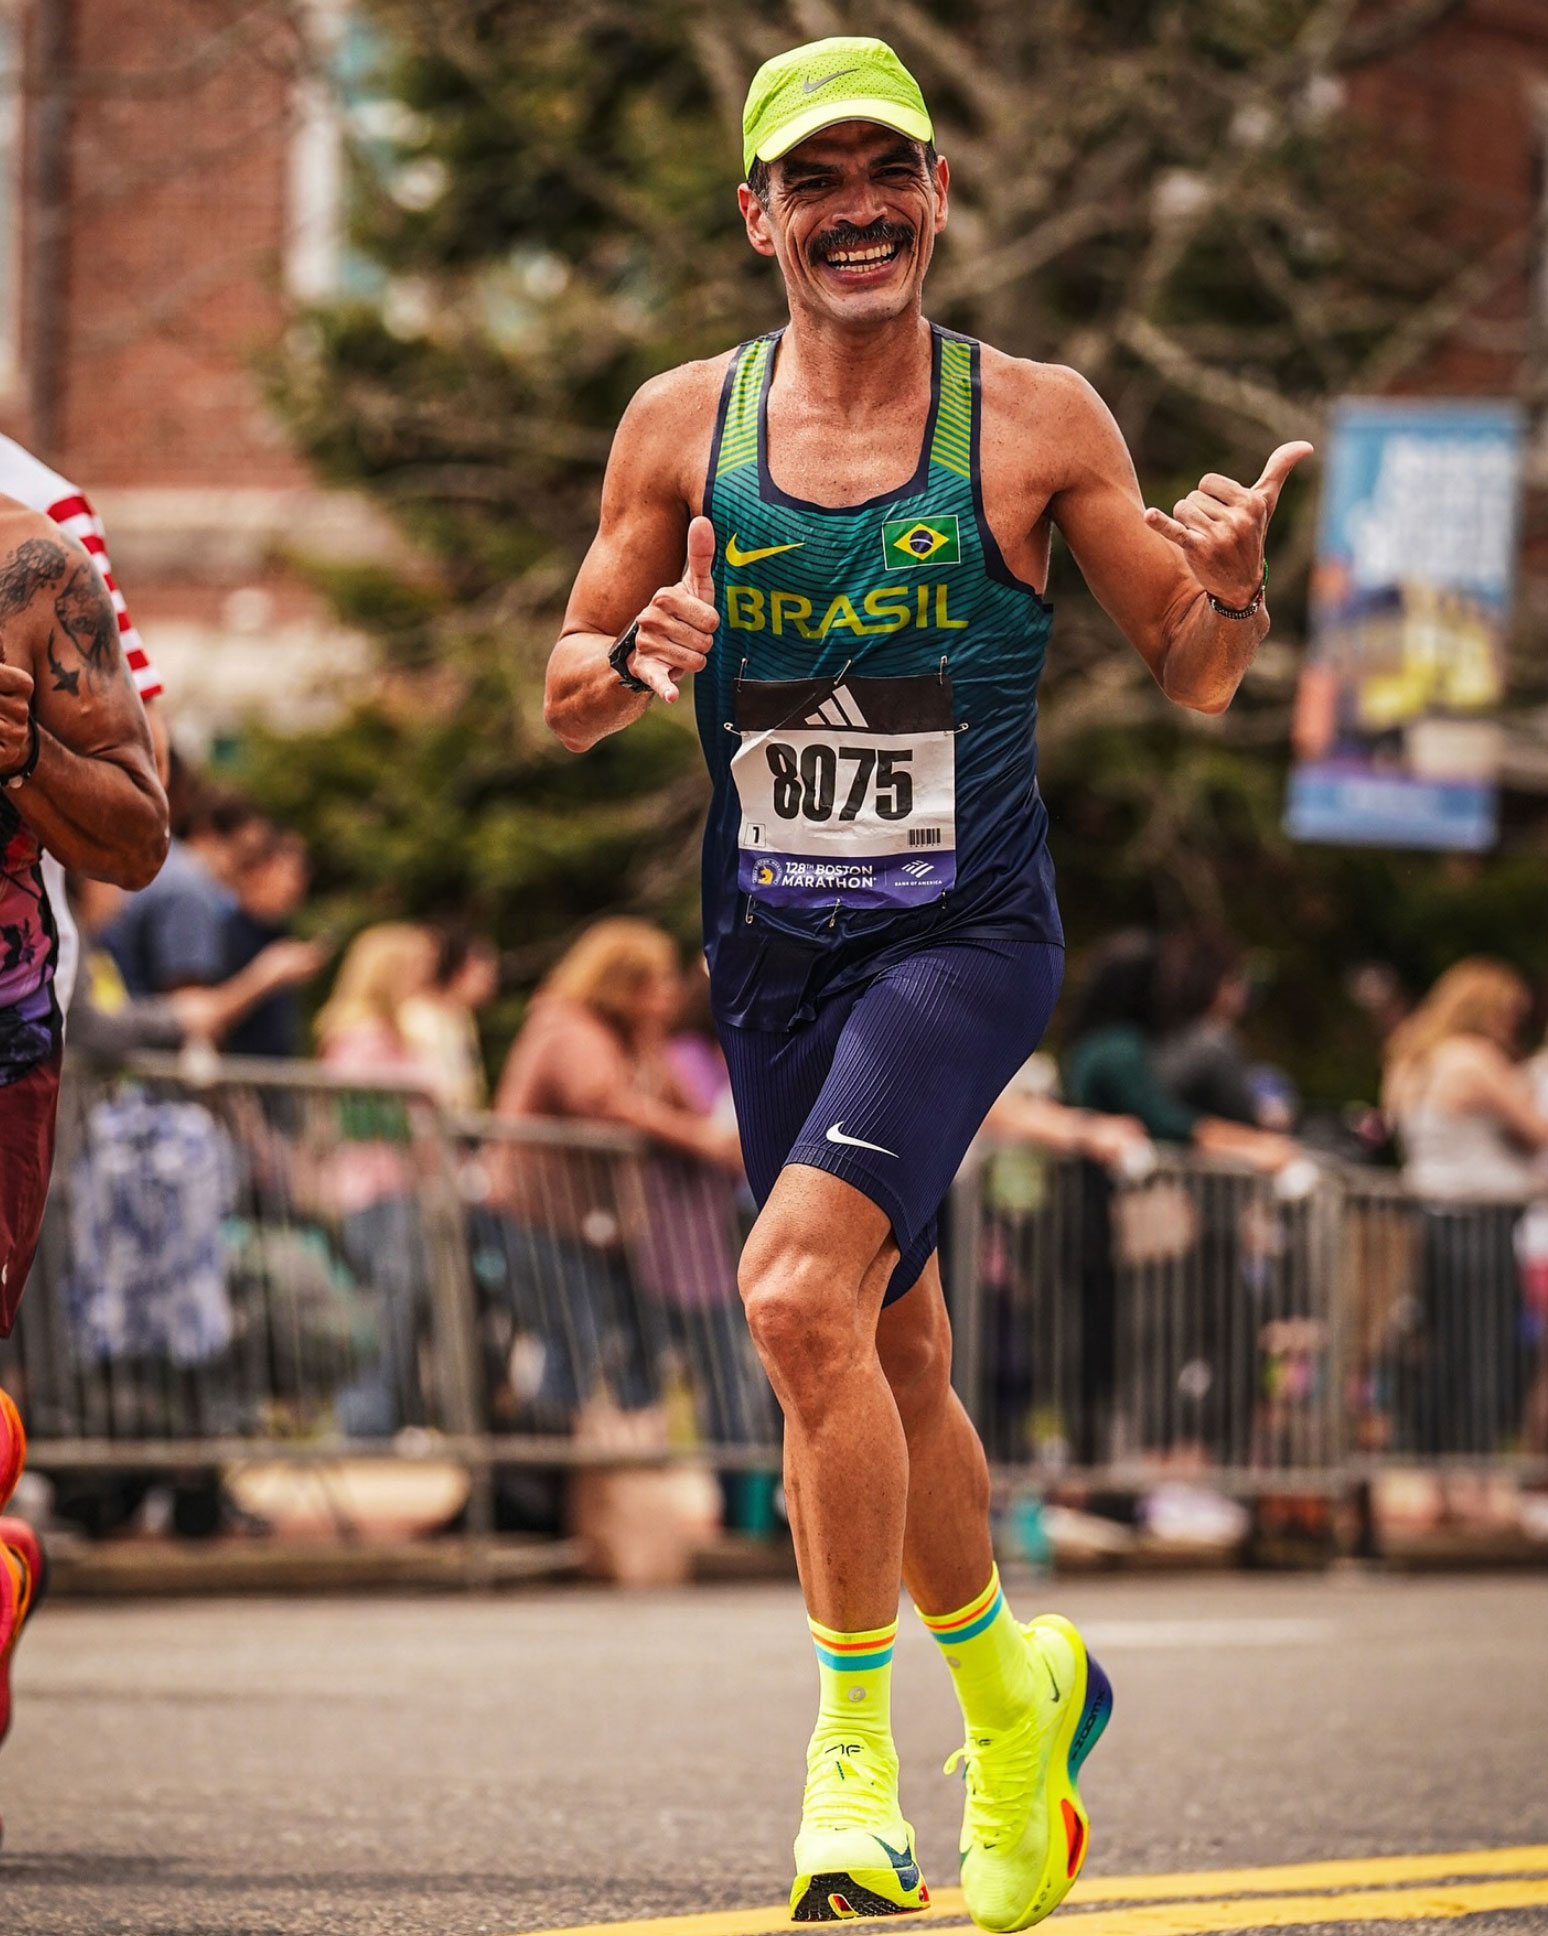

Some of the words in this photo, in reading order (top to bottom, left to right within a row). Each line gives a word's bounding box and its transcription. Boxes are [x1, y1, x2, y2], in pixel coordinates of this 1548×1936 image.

[726, 585, 969, 638] BRASIL
[765, 742, 914, 823] 8075
[815, 864, 873, 876] BOSTON
